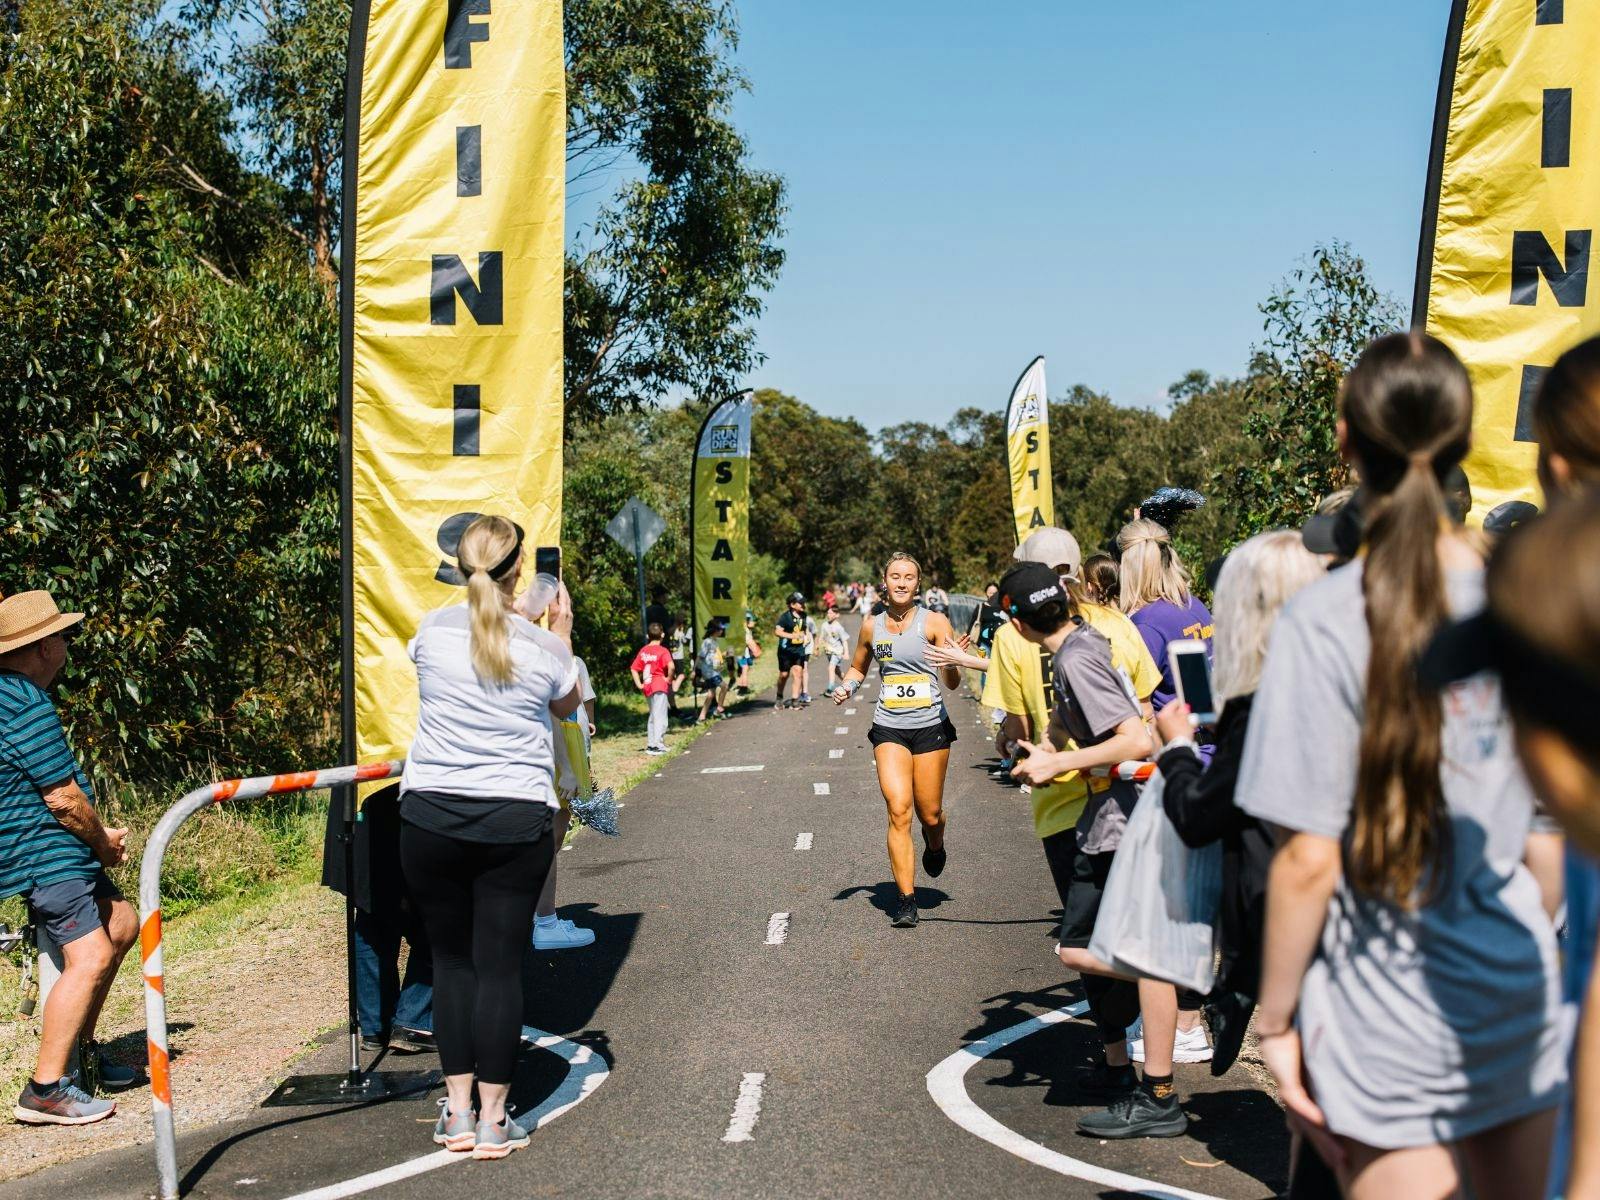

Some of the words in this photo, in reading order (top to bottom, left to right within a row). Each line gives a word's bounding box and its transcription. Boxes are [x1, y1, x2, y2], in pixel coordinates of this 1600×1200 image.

[1483, 0, 1592, 533] INI
[712, 429, 737, 440] RUN
[712, 440, 737, 449] DIPG
[876, 643, 892, 652] RUN
[896, 685, 916, 698] 36
